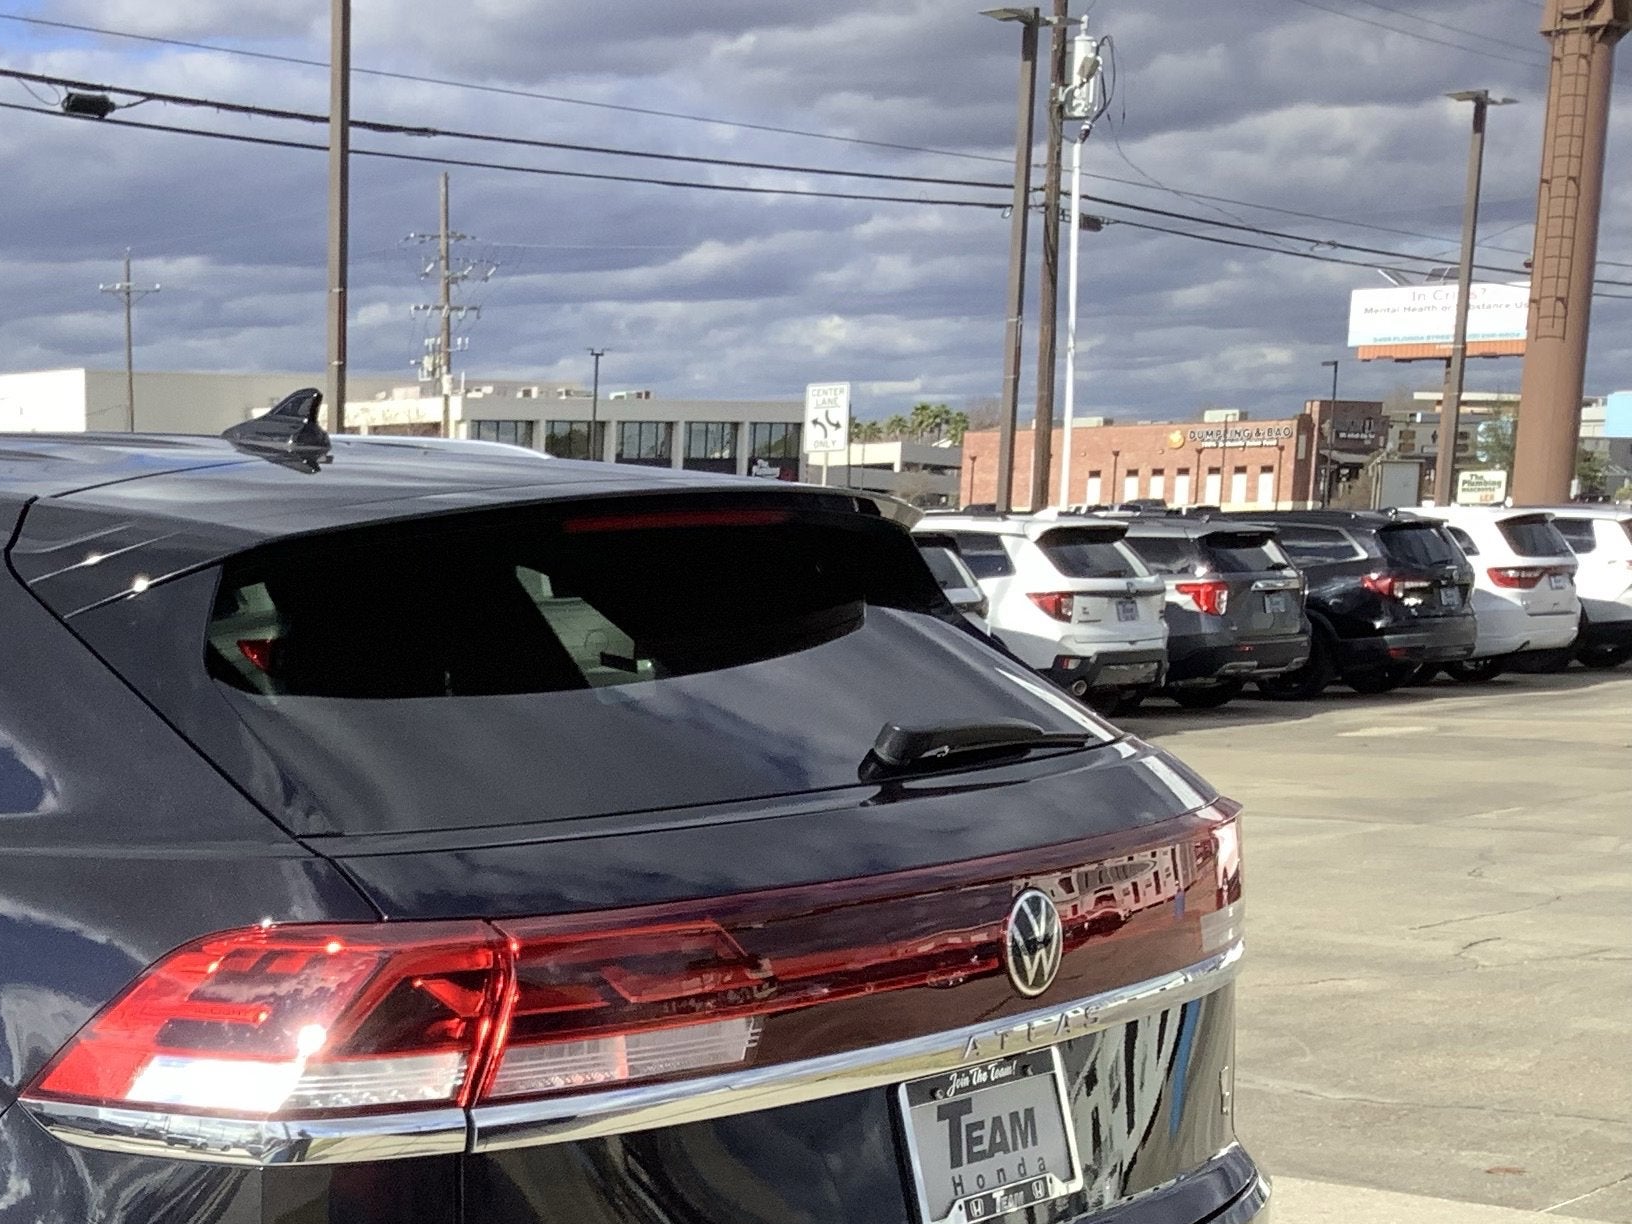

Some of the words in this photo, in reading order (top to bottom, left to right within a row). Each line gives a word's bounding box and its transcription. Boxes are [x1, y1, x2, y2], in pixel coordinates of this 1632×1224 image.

[1412, 291, 1426, 301] In
[1363, 306, 1400, 315] Mental
[1403, 304, 1438, 313] Health
[811, 388, 845, 397] CENTER
[816, 397, 839, 407] LANE
[1254, 427, 1265, 438] &
[1267, 426, 1293, 437] BAO
[814, 440, 837, 449] ONLY
[1462, 480, 1502, 489] Plumbing
[964, 1006, 1100, 1060] ATLAS
[946, 1070, 970, 1097] Join
[968, 1066, 989, 1086] The
[987, 1060, 1018, 1081] Team!
[936, 1097, 1039, 1170] TEAM
[952, 1155, 1047, 1197] Honda
